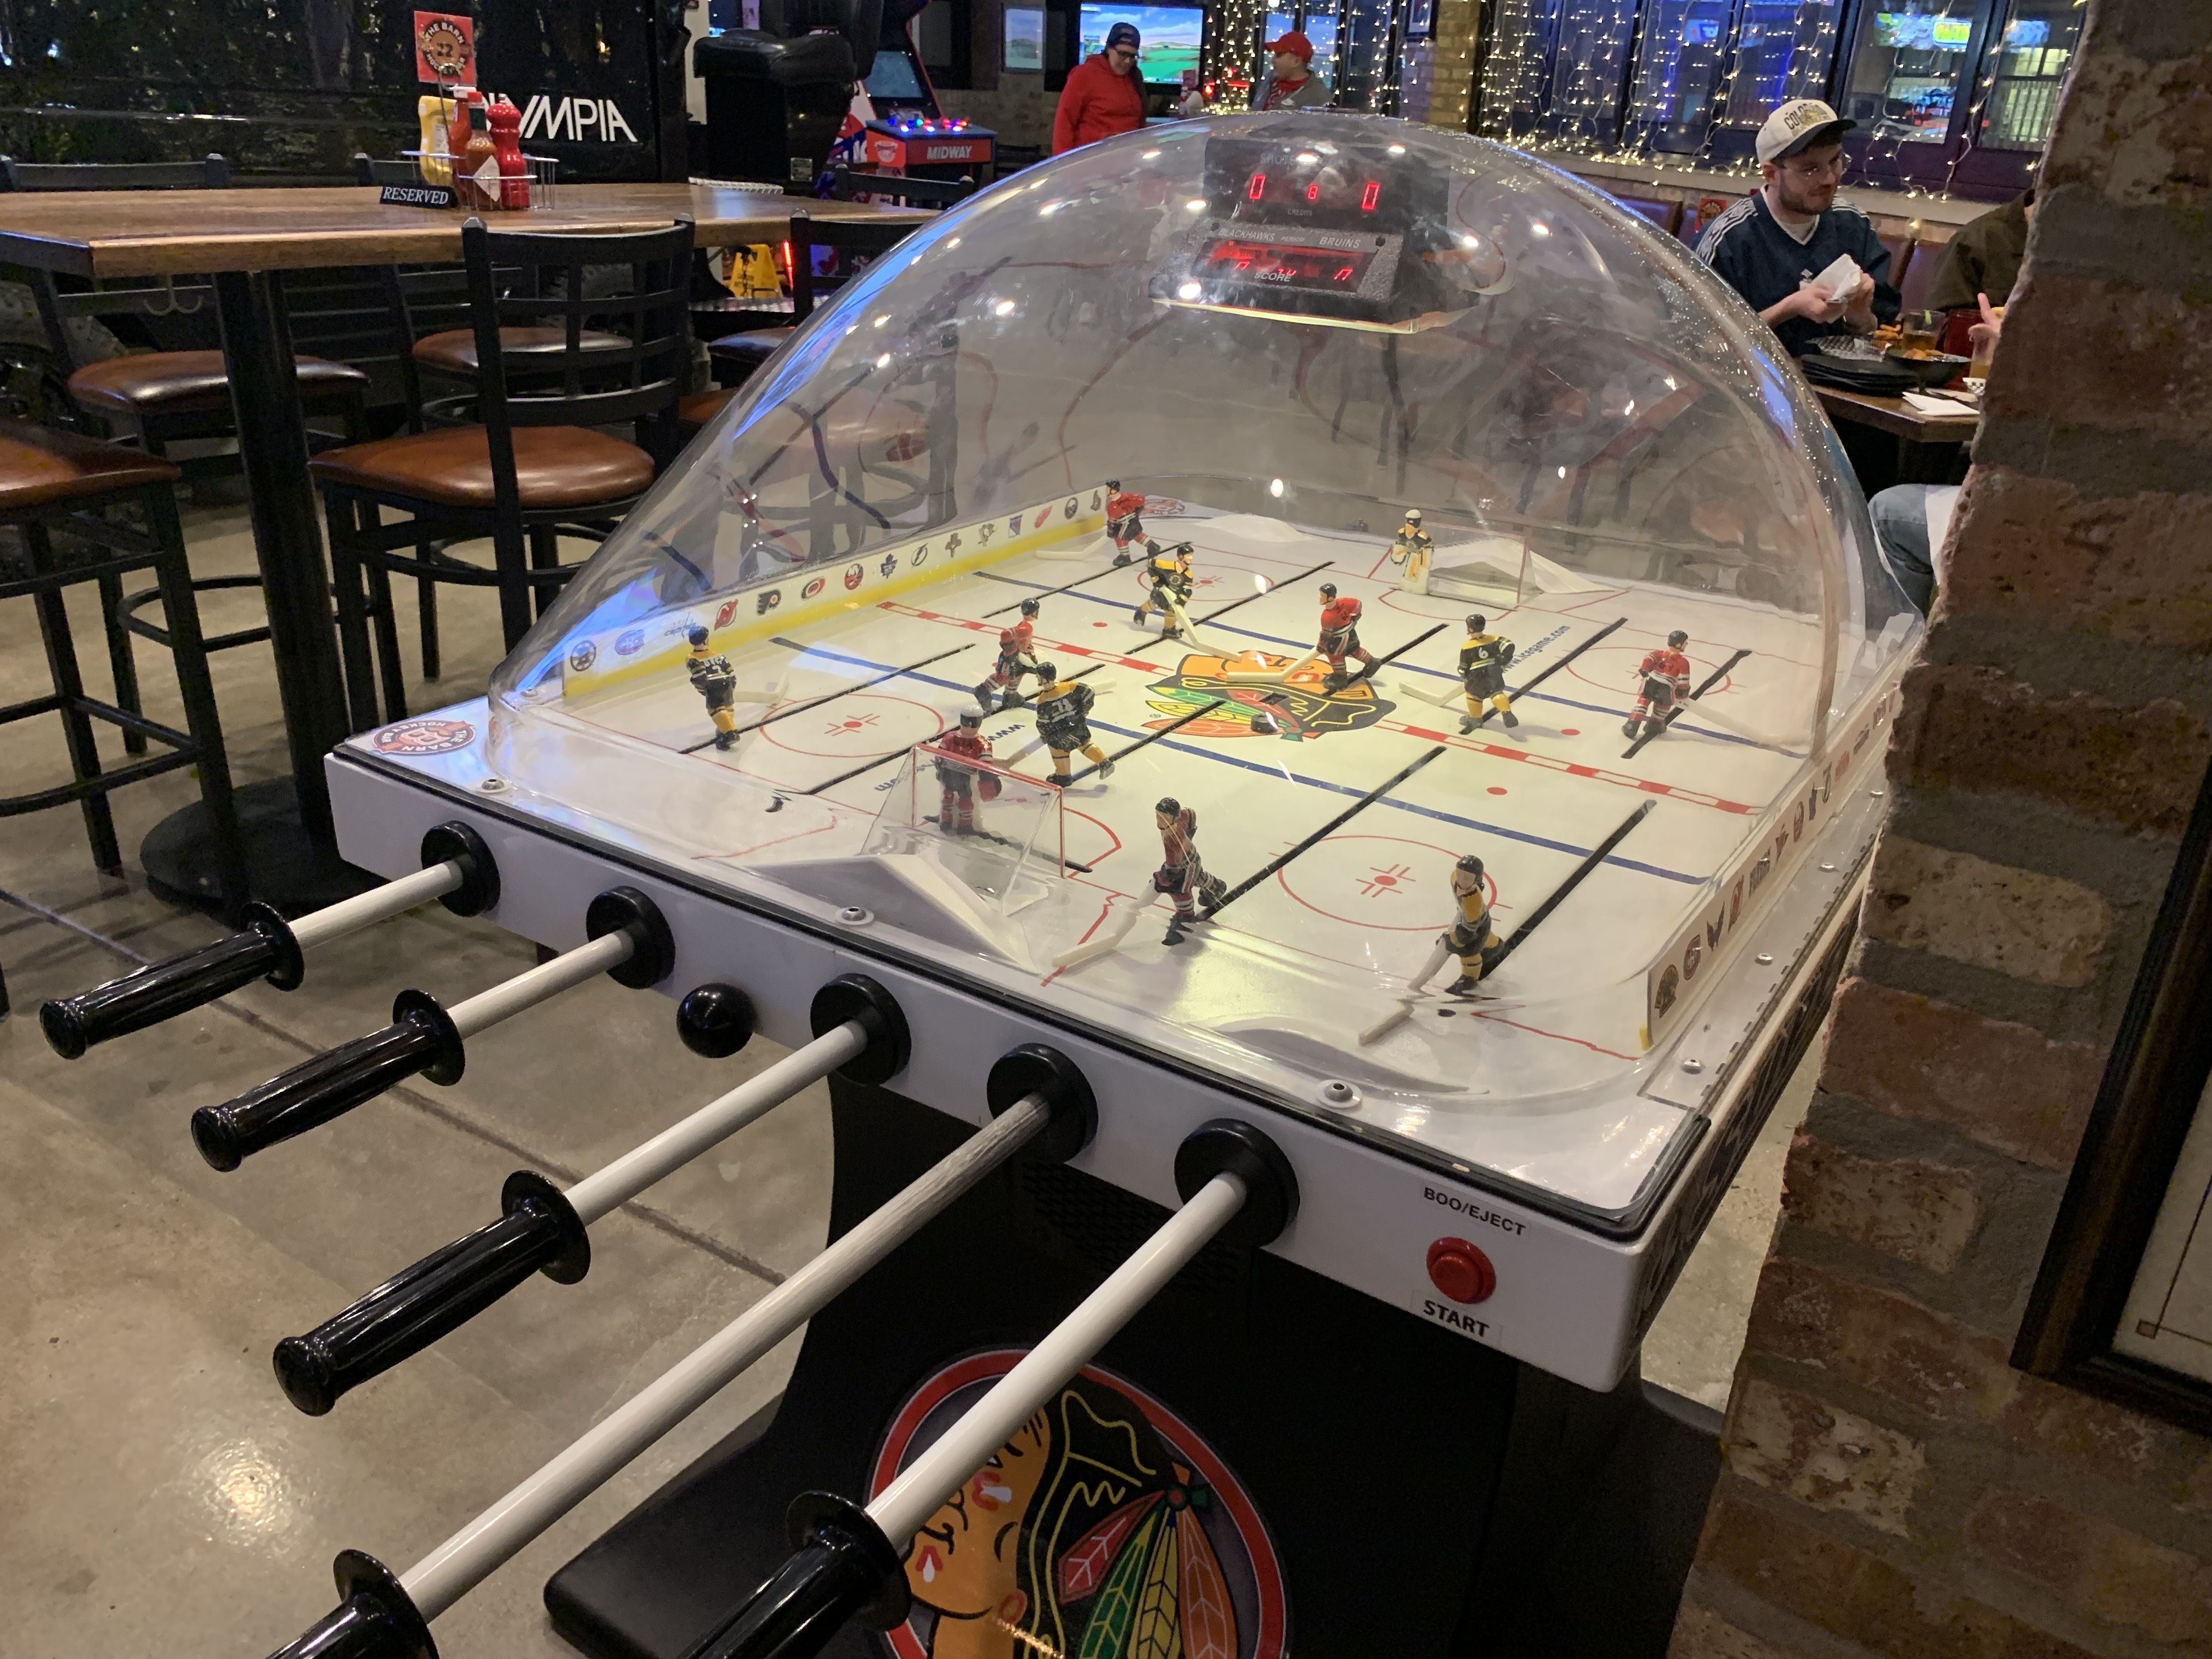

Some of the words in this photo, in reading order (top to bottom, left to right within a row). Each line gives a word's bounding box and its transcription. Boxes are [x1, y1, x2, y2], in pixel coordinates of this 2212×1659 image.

[425, 23, 440, 38] THE
[441, 22, 465, 43] BARN
[482, 93, 638, 142] YMPIA
[926, 145, 972, 160] MIDWAY
[382, 187, 449, 205] RESERVED
[1218, 228, 1276, 241] BLACKHAWKS
[1319, 236, 1362, 249] BRUINS
[1254, 272, 1293, 283] SCORE
[392, 721, 447, 732] HOCKEY
[381, 732, 394, 743] BAR
[450, 729, 468, 743] THE
[401, 742, 453, 752] BARN
[1424, 1187, 1526, 1236] BOO/EJECT
[1423, 1299, 1491, 1338] START
